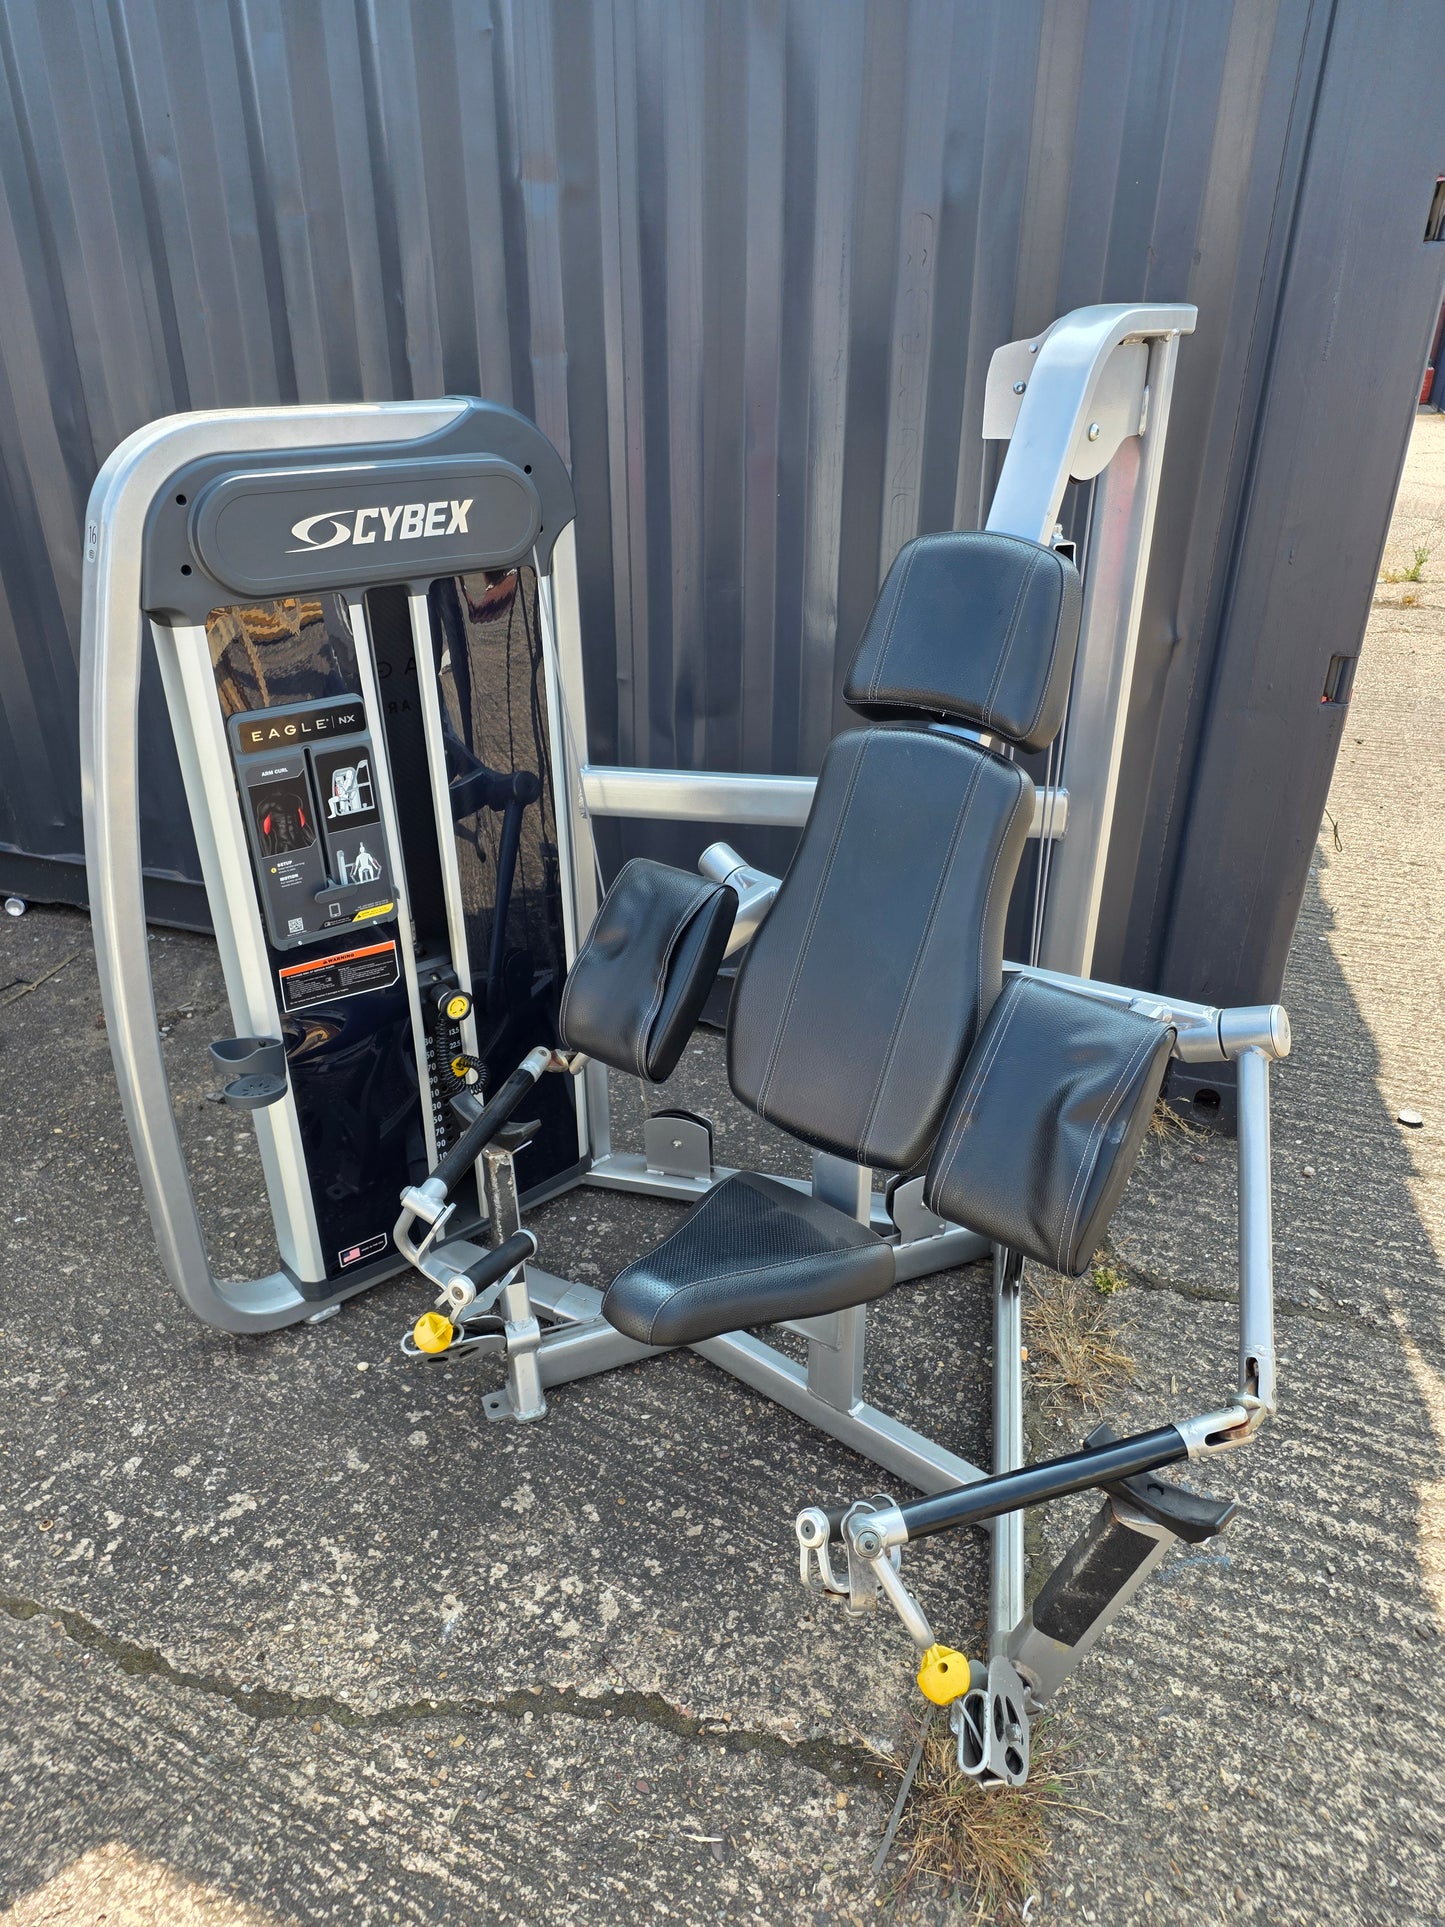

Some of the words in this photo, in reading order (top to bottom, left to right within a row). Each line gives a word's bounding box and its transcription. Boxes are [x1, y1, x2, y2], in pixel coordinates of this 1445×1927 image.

[352, 499, 473, 545] CYBEX
[89, 526, 97, 544] 16
[251, 718, 327, 742] EAGLE
[338, 714, 355, 725] NX
[261, 769, 273, 778] ARM
[274, 767, 289, 776] CURL
[328, 953, 355, 963] WARNING
